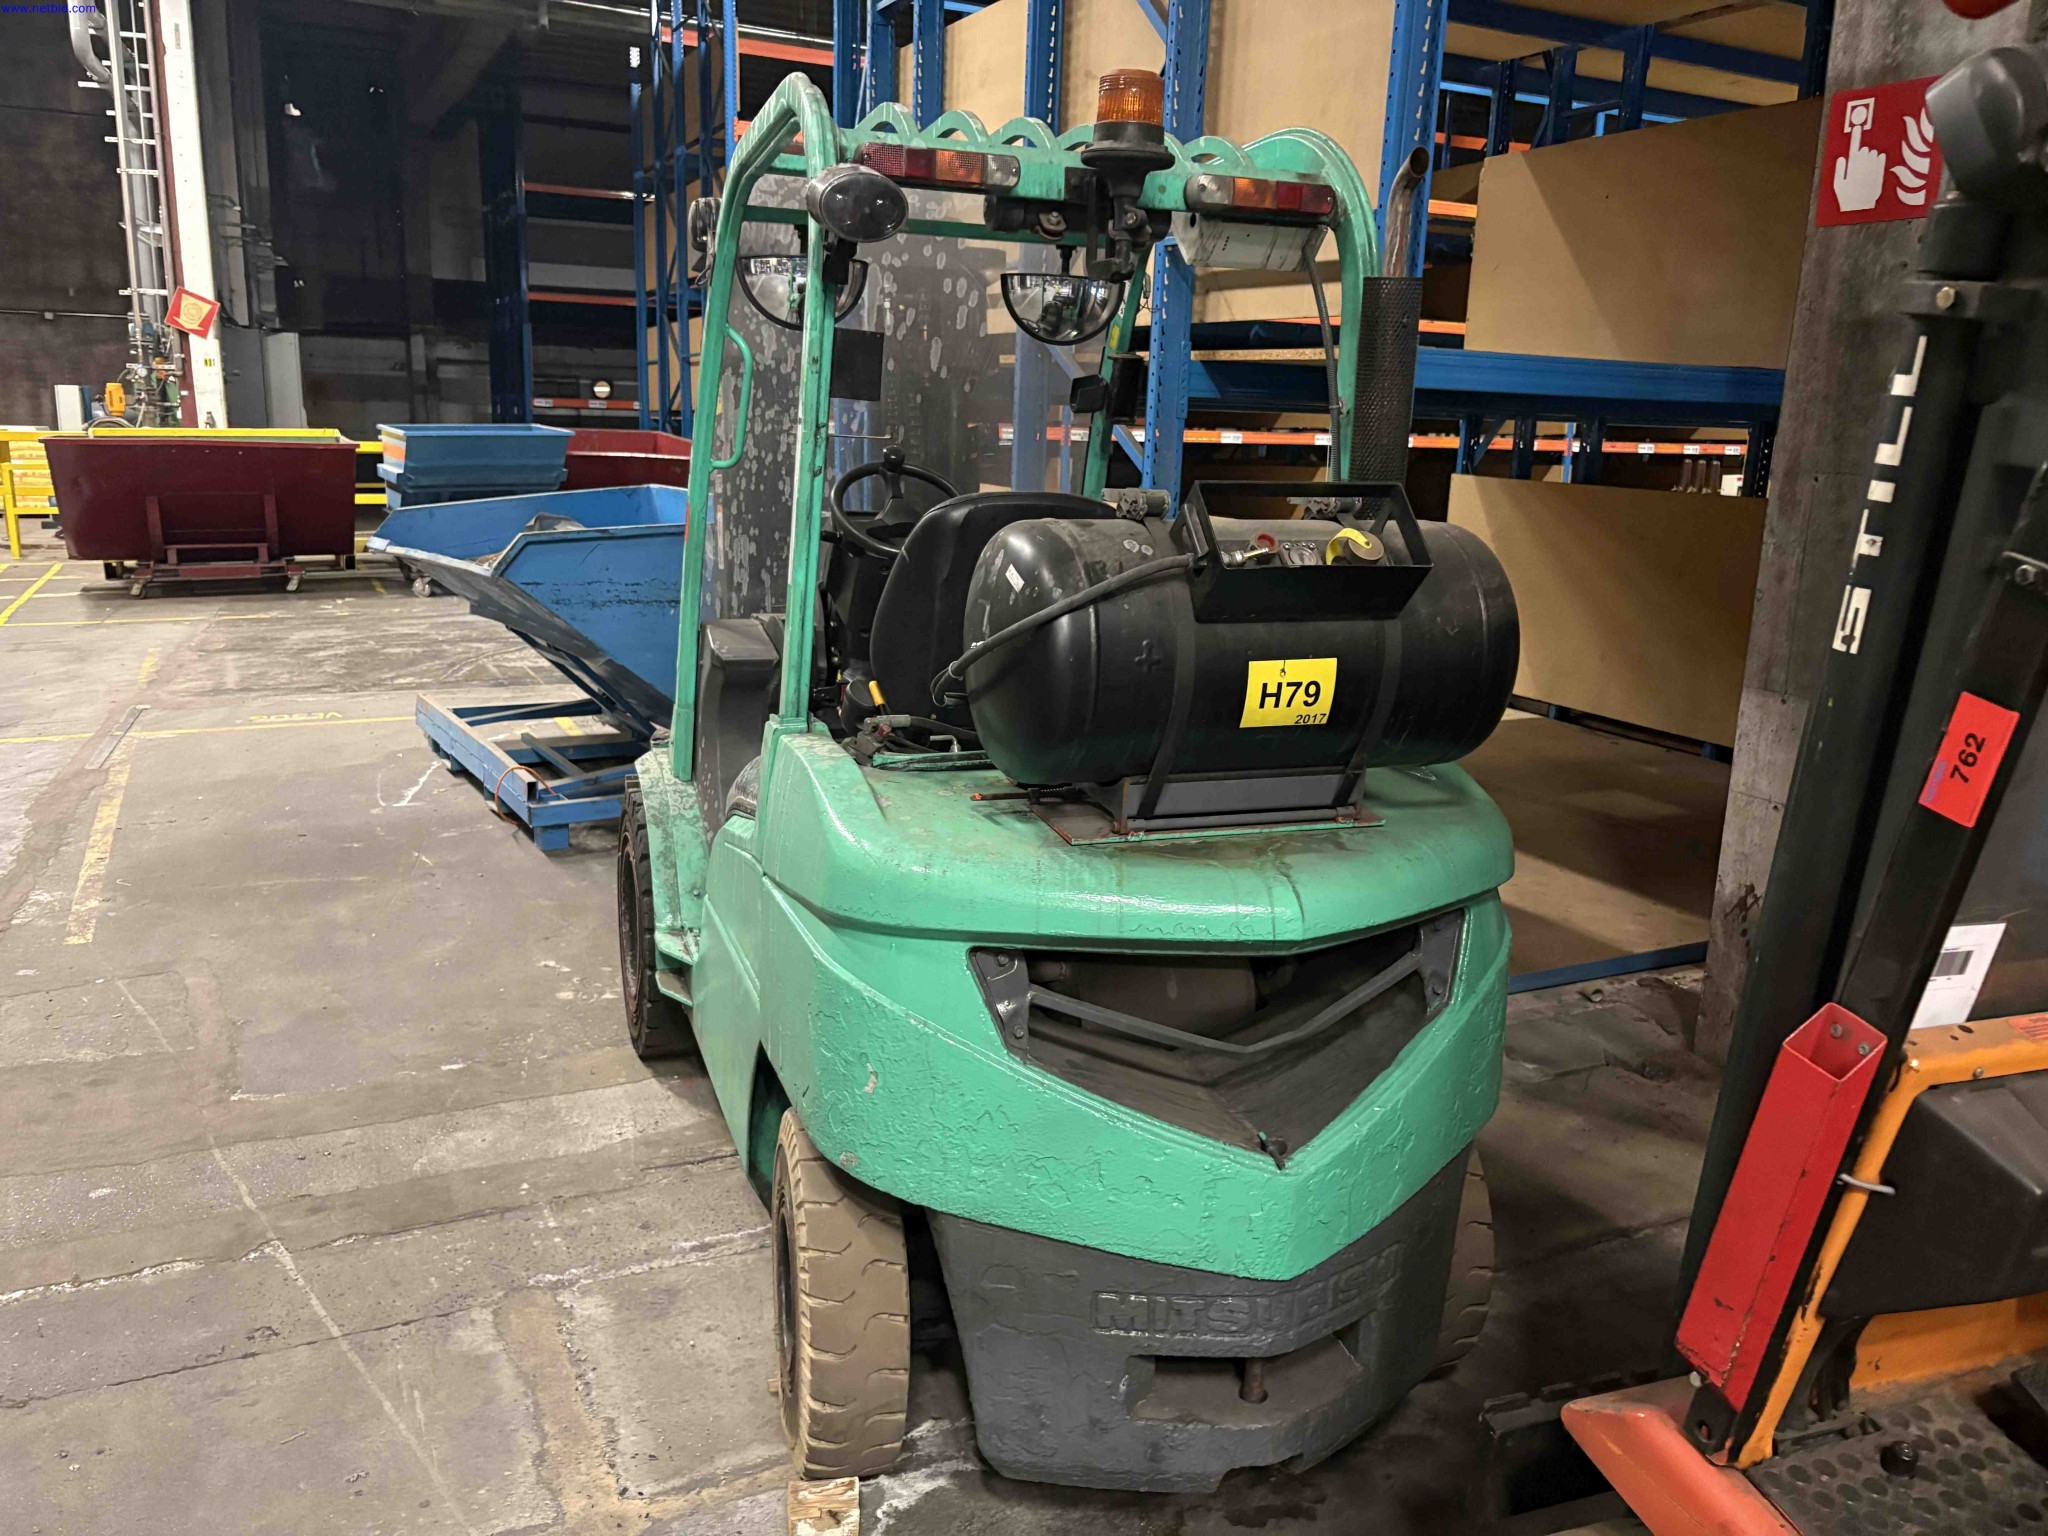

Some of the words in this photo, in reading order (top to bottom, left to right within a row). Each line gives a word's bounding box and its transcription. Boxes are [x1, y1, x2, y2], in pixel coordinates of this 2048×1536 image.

[1832, 335, 1927, 654] STILL
[1259, 681, 1321, 709] H79
[1295, 713, 1327, 724] 2017
[1949, 732, 1987, 784] 762
